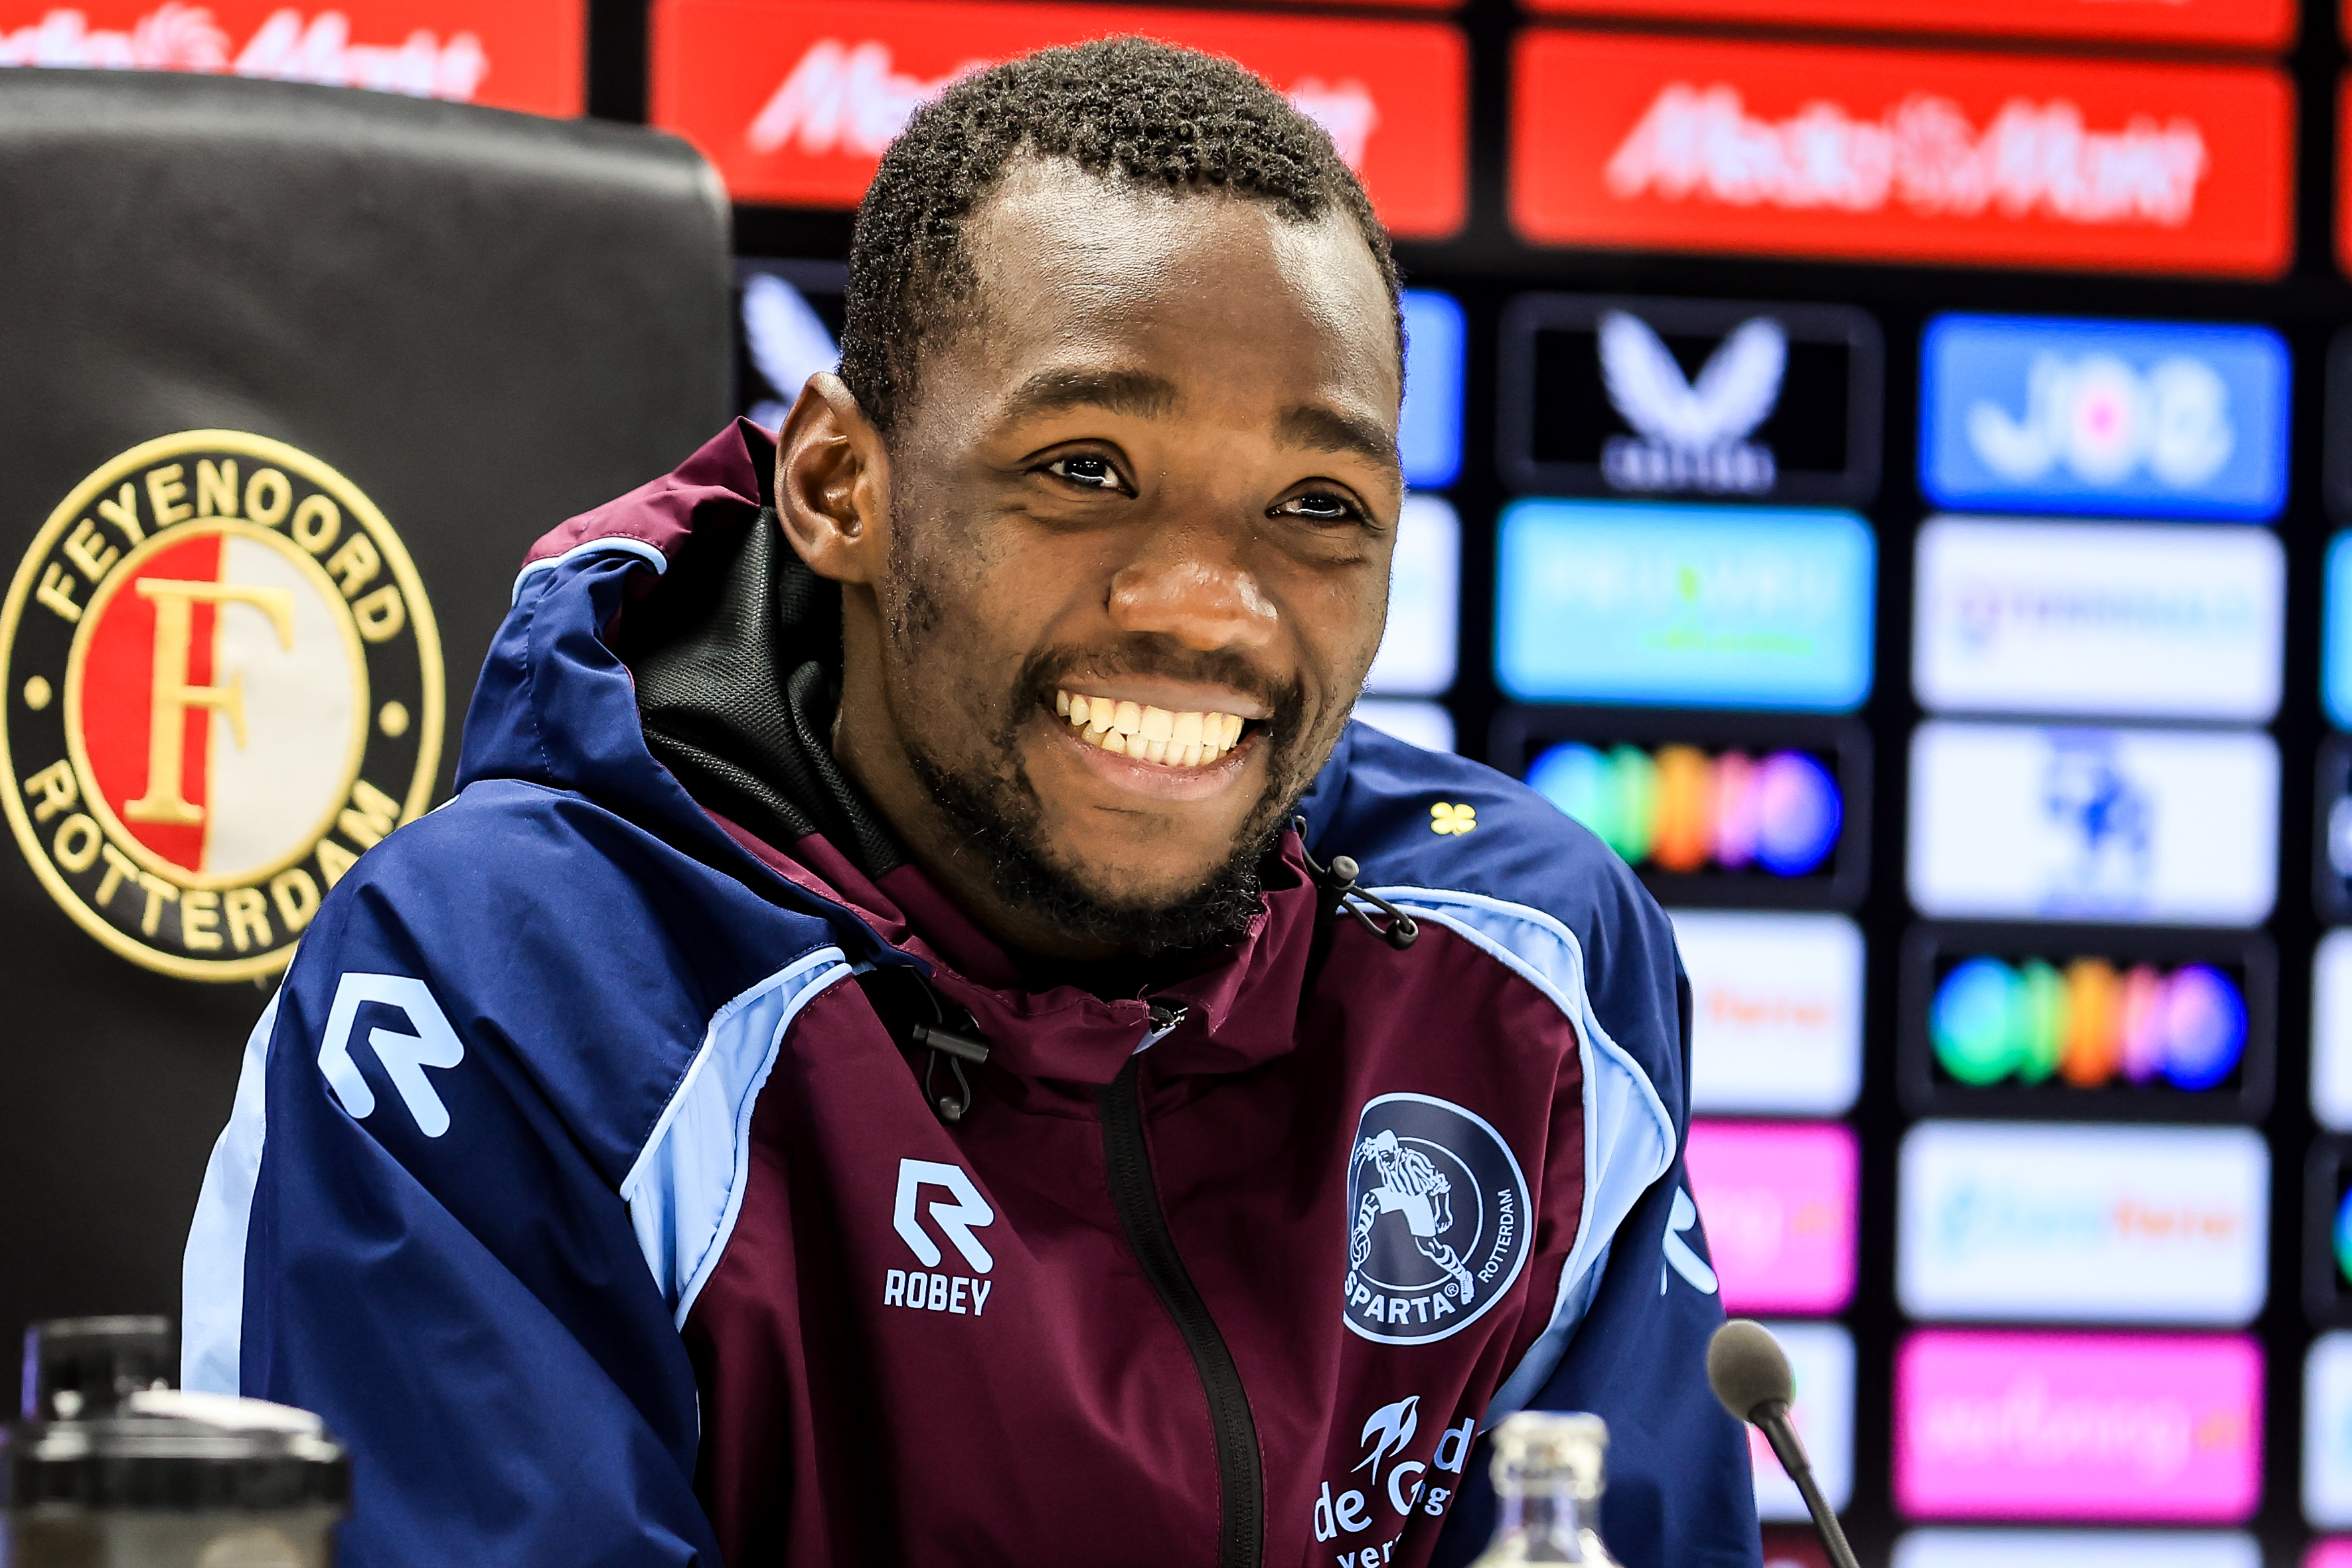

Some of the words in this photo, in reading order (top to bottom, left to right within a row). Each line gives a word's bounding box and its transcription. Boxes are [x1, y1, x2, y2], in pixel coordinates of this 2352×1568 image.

[37, 458, 406, 643] FEYENOORD
[123, 577, 296, 824] F
[25, 759, 401, 951] ROTTERDAM
[884, 1269, 991, 1316] ROBEY
[1477, 1188, 1515, 1283] ROTTERDAM
[1314, 1480, 1373, 1543] de
